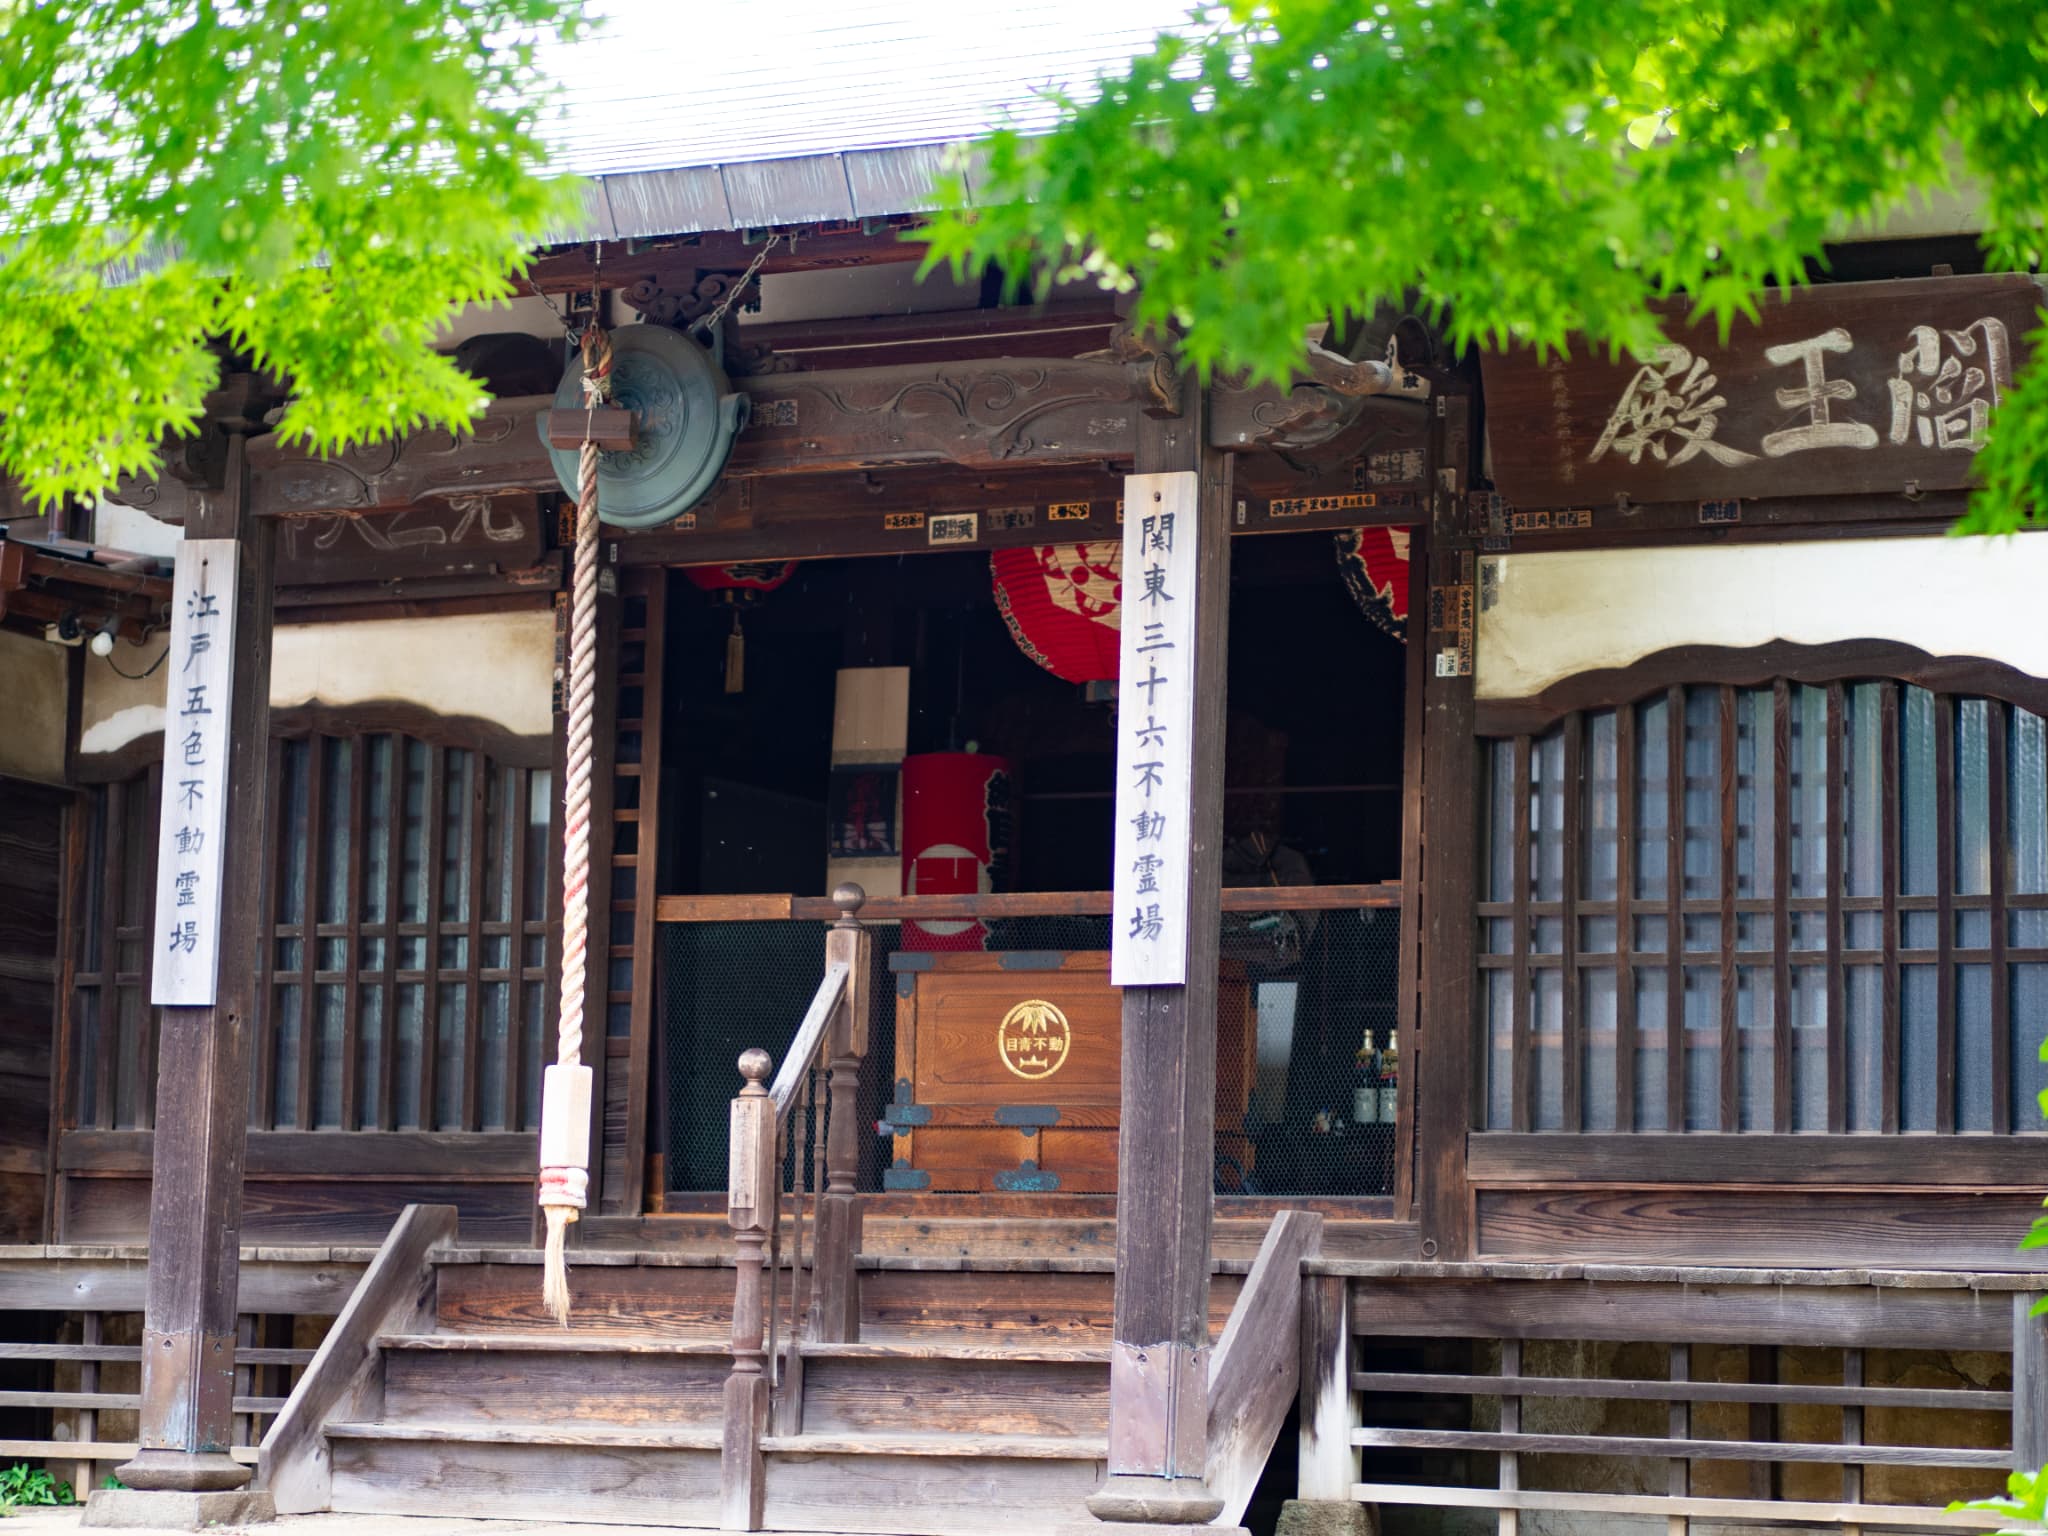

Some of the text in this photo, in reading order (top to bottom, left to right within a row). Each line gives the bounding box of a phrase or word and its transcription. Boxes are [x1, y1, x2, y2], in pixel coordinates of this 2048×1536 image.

[170, 592, 219, 953] 江戸五色不動霊場
[1129, 513, 1175, 941] 関東三十六不動霊場
